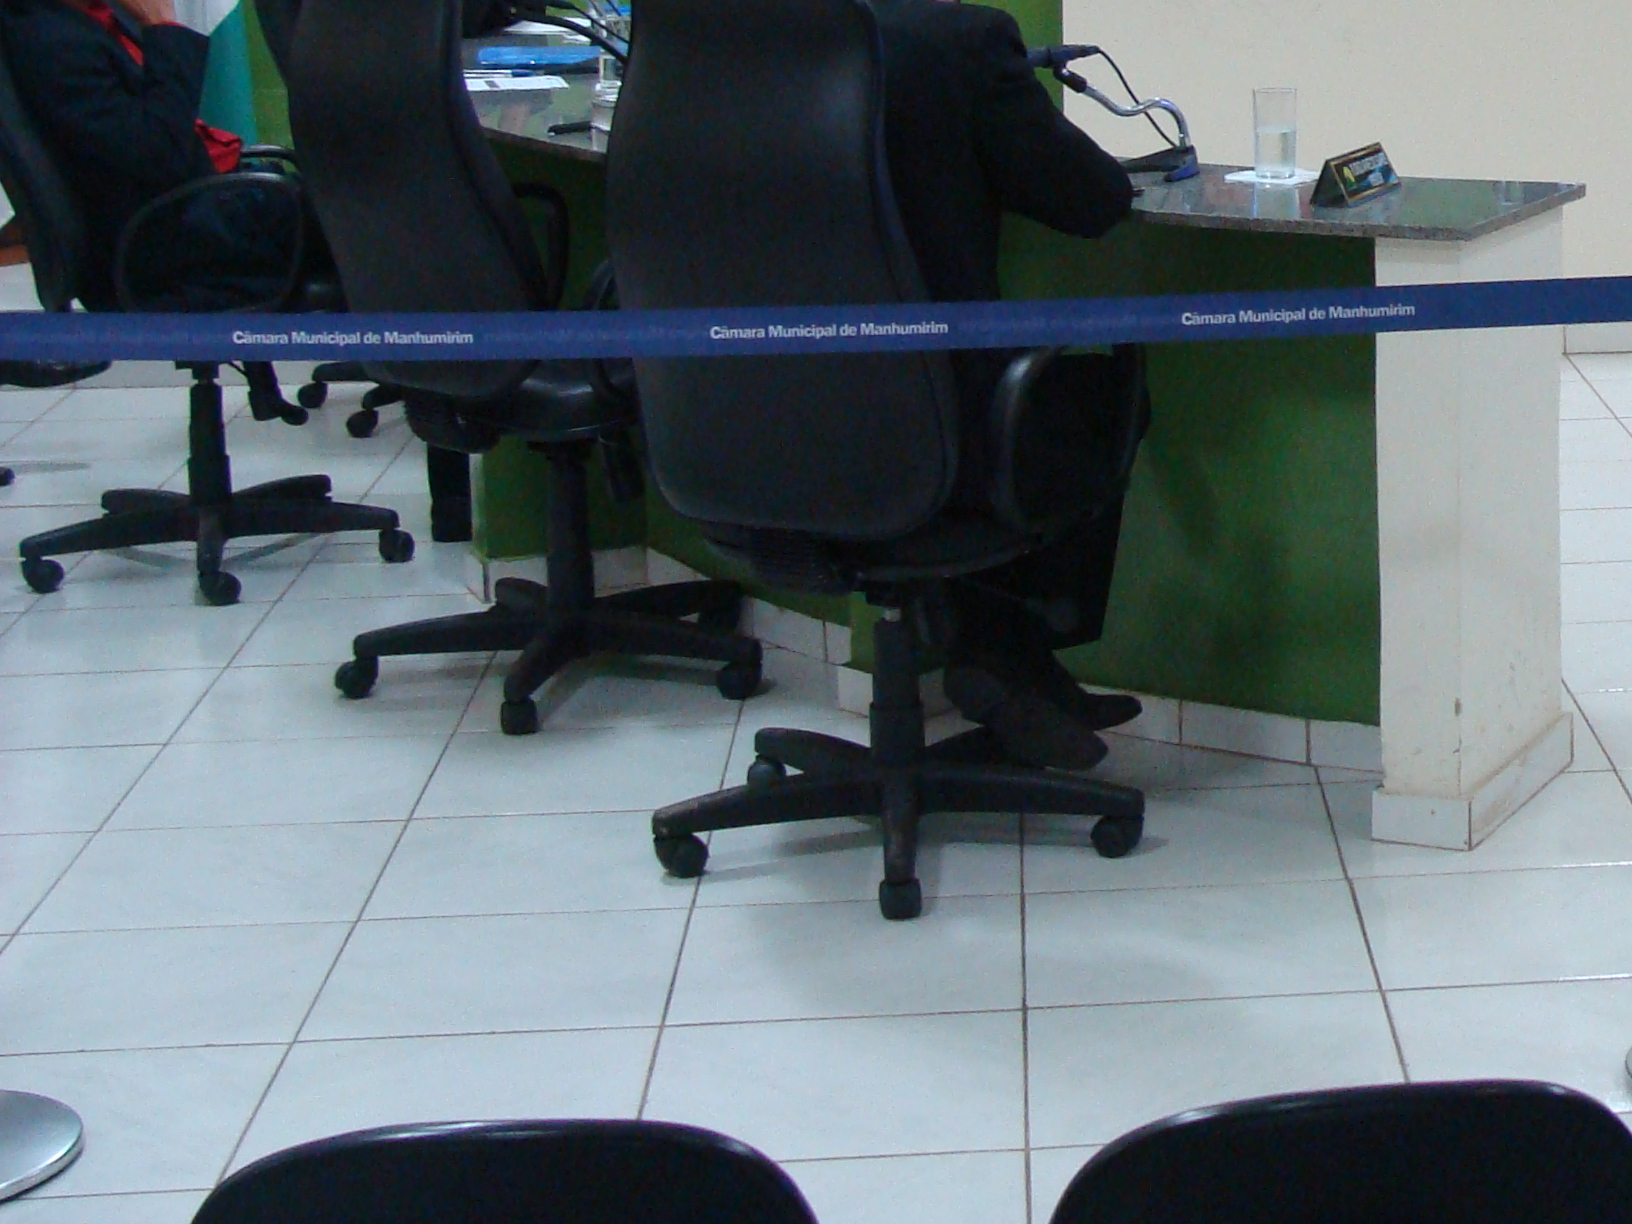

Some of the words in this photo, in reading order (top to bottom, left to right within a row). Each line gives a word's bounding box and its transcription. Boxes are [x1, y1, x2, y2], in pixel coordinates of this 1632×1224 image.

[1181, 311, 1237, 326] Câmara
[1238, 308, 1306, 324] Municipal
[1308, 307, 1326, 320] de
[1328, 302, 1416, 319] Manhumirim
[232, 330, 289, 345] Câmara
[291, 330, 361, 347] Municipal
[363, 331, 382, 344] de
[384, 330, 474, 344] Manhumirim
[709, 325, 766, 340] Câmara
[768, 323, 837, 339] Municipal
[839, 323, 858, 337] de
[860, 320, 949, 336] Manhumirim
